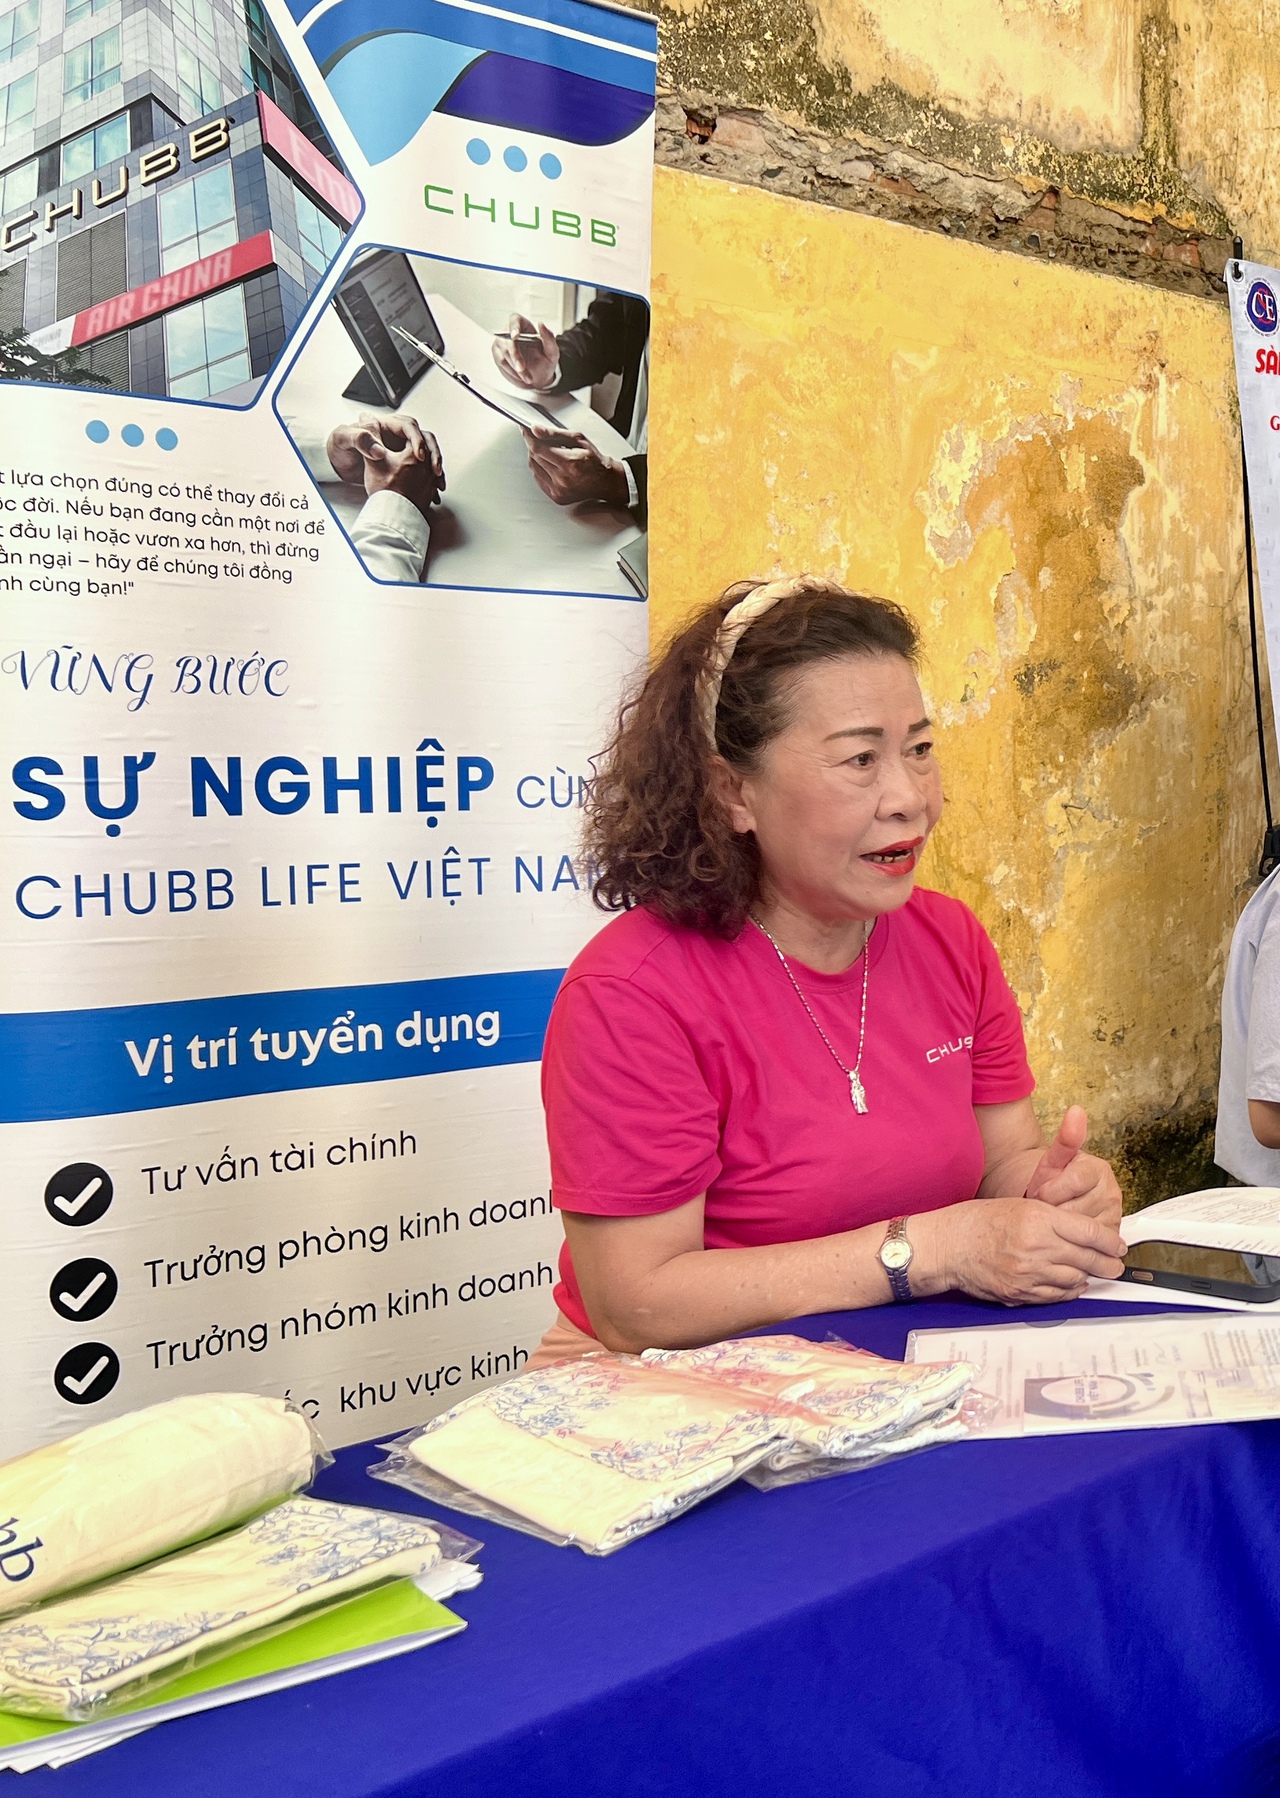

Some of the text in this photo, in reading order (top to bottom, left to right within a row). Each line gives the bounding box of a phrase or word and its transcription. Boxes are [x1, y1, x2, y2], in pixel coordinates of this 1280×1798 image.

[2, 118, 230, 252] CHUBB
[424, 184, 617, 248] CHUBB
[86, 249, 233, 339] AIR CHINA
[11, 469, 309, 510] lựa chọn đúng có thể thay đổi cả
[23, 496, 60, 514] đời.
[66, 496, 104, 517] Nếu
[110, 502, 144, 522] bạn
[149, 507, 197, 528] đang
[201, 508, 234, 528] cần
[239, 515, 271, 533] một
[275, 519, 300, 534] nơi
[304, 518, 325, 536] để
[9, 519, 51, 539] đầu
[57, 524, 78, 544] lại
[84, 526, 131, 546] hoặc
[135, 533, 180, 549] vươn
[184, 537, 205, 550] xa
[210, 536, 246, 556] hơn,
[250, 540, 271, 556] thì
[275, 542, 320, 562] đừng
[29, 551, 293, 585] ngại hãy để chúng tôi đồng
[29, 576, 134, 598] cùng bạn!"
[1, 645, 290, 712] VỮNG BƯỚC
[11, 738, 598, 838] SỰ NGHIỆP CÙN
[15, 868, 235, 920] CHUBB
[260, 862, 363, 908] LIFE
[387, 845, 491, 906] VIỆT
[124, 1008, 501, 1084] Vị trí tuyển dụng
[141, 1130, 418, 1197] Tư vấn tài chính
[144, 1243, 267, 1290] Trưởng
[278, 1221, 389, 1270] phòng
[398, 1207, 460, 1243] kinh
[146, 1262, 553, 1371] Trưởng nhóm kinh doanh
[340, 1380, 396, 1413] khu
[405, 1365, 462, 1396] vực
[471, 1346, 528, 1380] kinh
